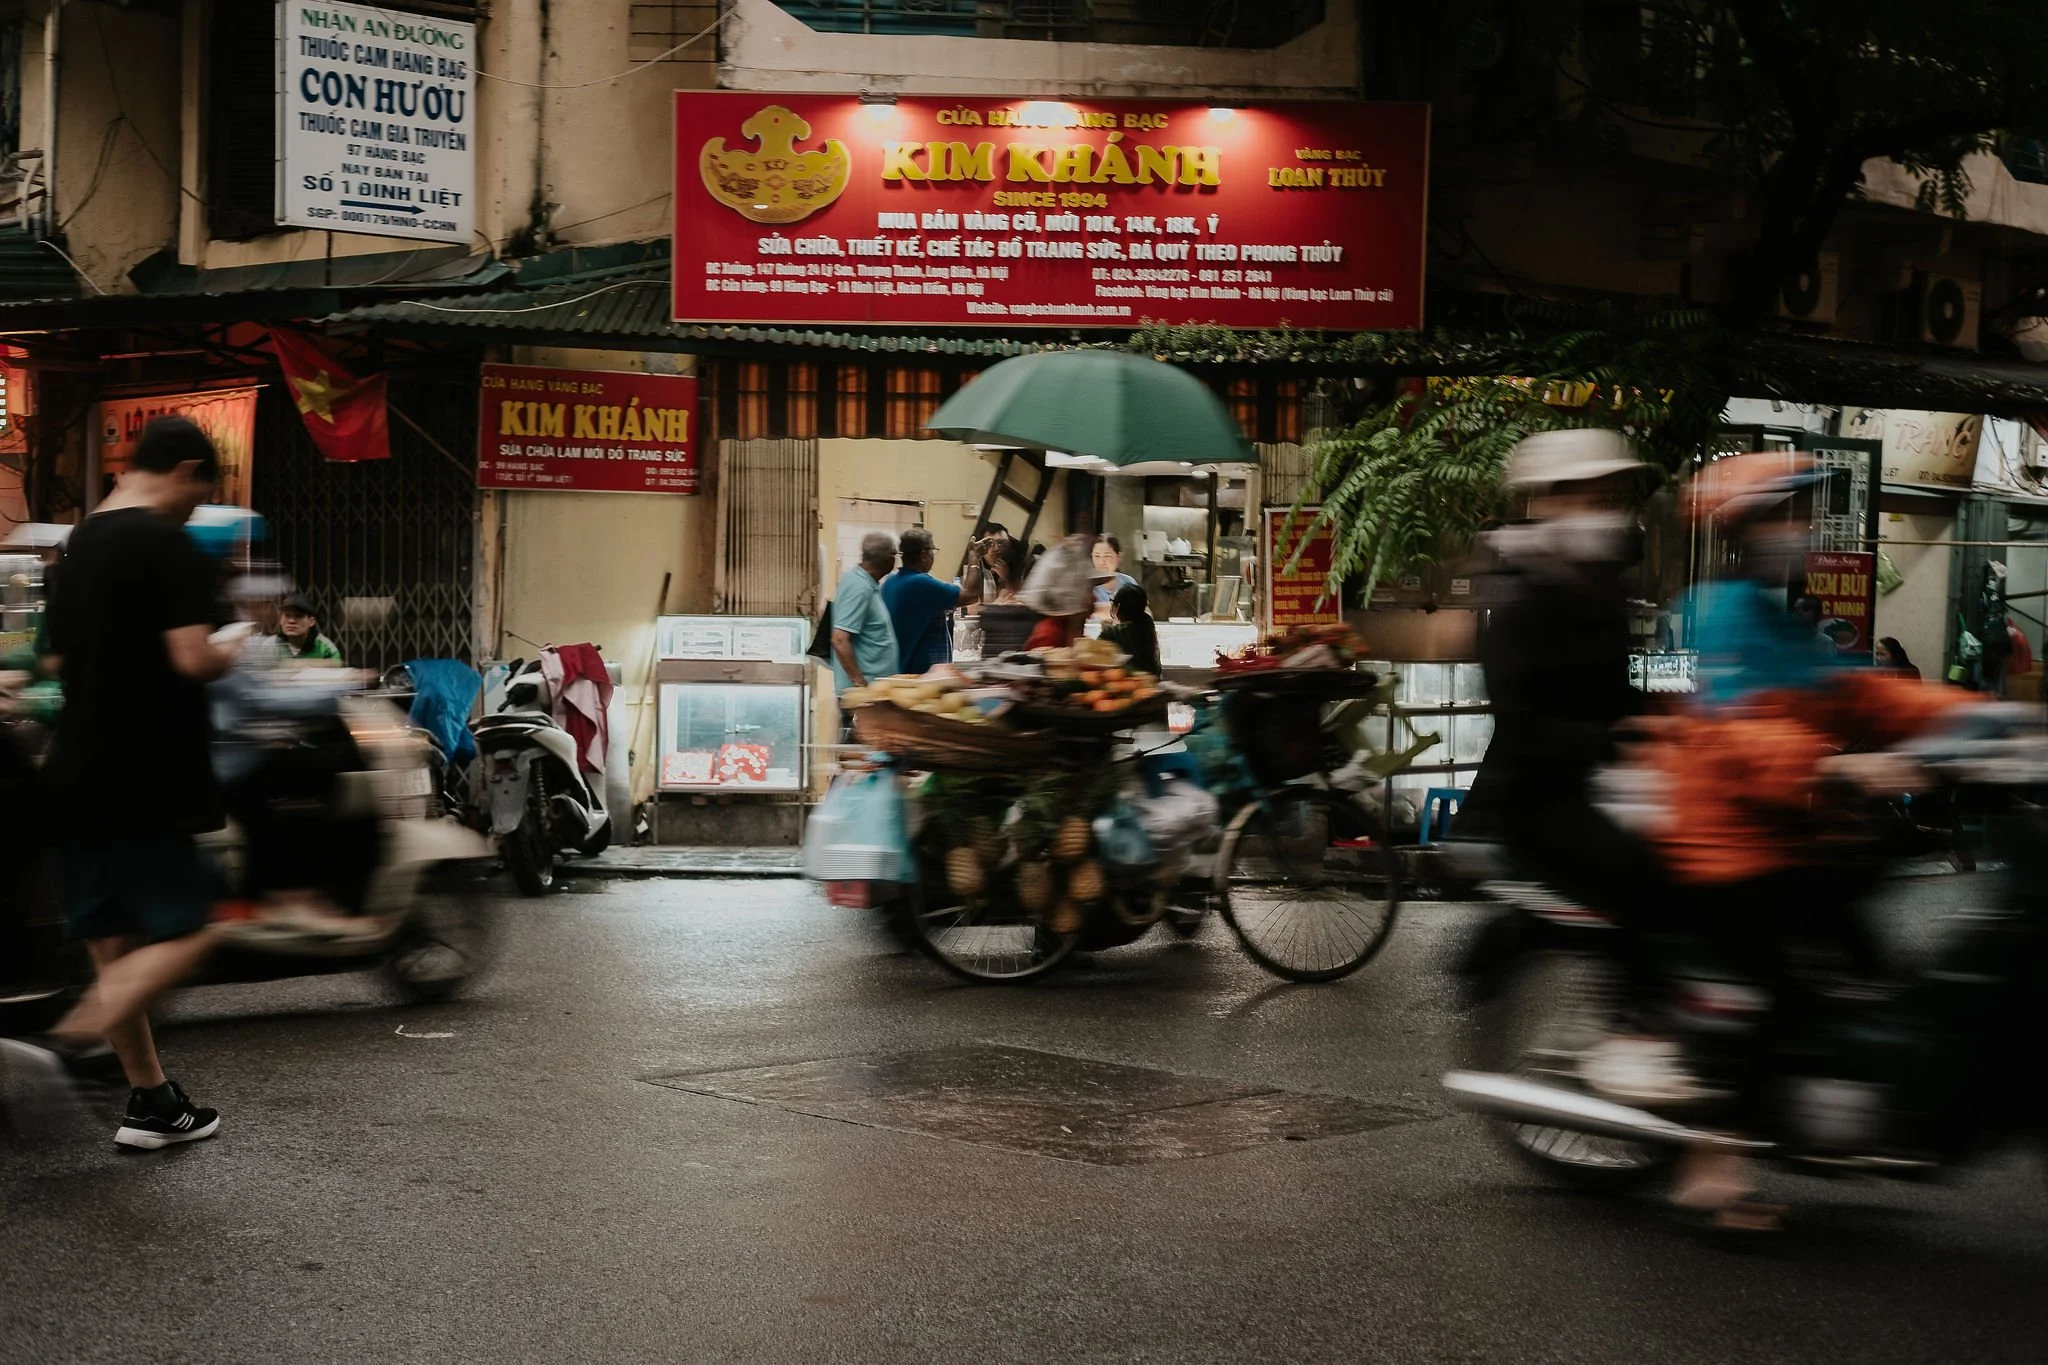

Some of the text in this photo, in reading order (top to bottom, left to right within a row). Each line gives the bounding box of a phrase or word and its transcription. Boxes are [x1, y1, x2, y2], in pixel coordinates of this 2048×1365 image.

[363, 19, 389, 38] AN
[298, 33, 467, 82] THUỐC CAM HÀNG BẠC
[301, 67, 466, 123] CON HƯƠU
[298, 108, 345, 136] THUỐC
[351, 119, 382, 140] CAM
[387, 124, 410, 144] GIA
[936, 104, 982, 126] CỬA
[1123, 112, 1168, 131] BẠC
[347, 143, 426, 166] 97 HÀNG BẠC
[881, 132, 1222, 186] KIM KHÁNH
[341, 163, 371, 174] NAY
[408, 170, 429, 184] TẠI
[1268, 162, 1387, 187] LOAN THỦY
[303, 170, 463, 208] SỐ 1 ĐINH LIỆT
[993, 191, 1108, 208] SINCE 1994
[878, 212, 918, 230] MUA
[921, 208, 959, 230] BÁN
[963, 209, 1010, 232] VÀNG
[1044, 211, 1081, 232] MỚI
[758, 232, 792, 255] SỬA
[794, 234, 845, 257] CHỮA,
[846, 234, 894, 256] THIẾT
[926, 234, 962, 257] CHẾ
[963, 236, 995, 258] TÁC
[997, 236, 1023, 258] ĐỒ
[1025, 241, 1084, 259] TRANG
[1086, 238, 1127, 262] SỨC,
[1195, 243, 1238, 261] THEO
[1241, 244, 1297, 263] PHONG
[1300, 239, 1343, 263] THỦY
[769, 280, 783, 292] 99
[1329, 288, 1352, 301] Loan
[581, 382, 604, 397] BẠC
[500, 397, 689, 443] KIM KHÁNH
[526, 443, 555, 458] CHỮA
[628, 449, 662, 461] TRANG
[664, 448, 686, 462] SỨC
[1895, 419, 1971, 460] TRANG
[1805, 568, 1868, 597] NEM BÙI
